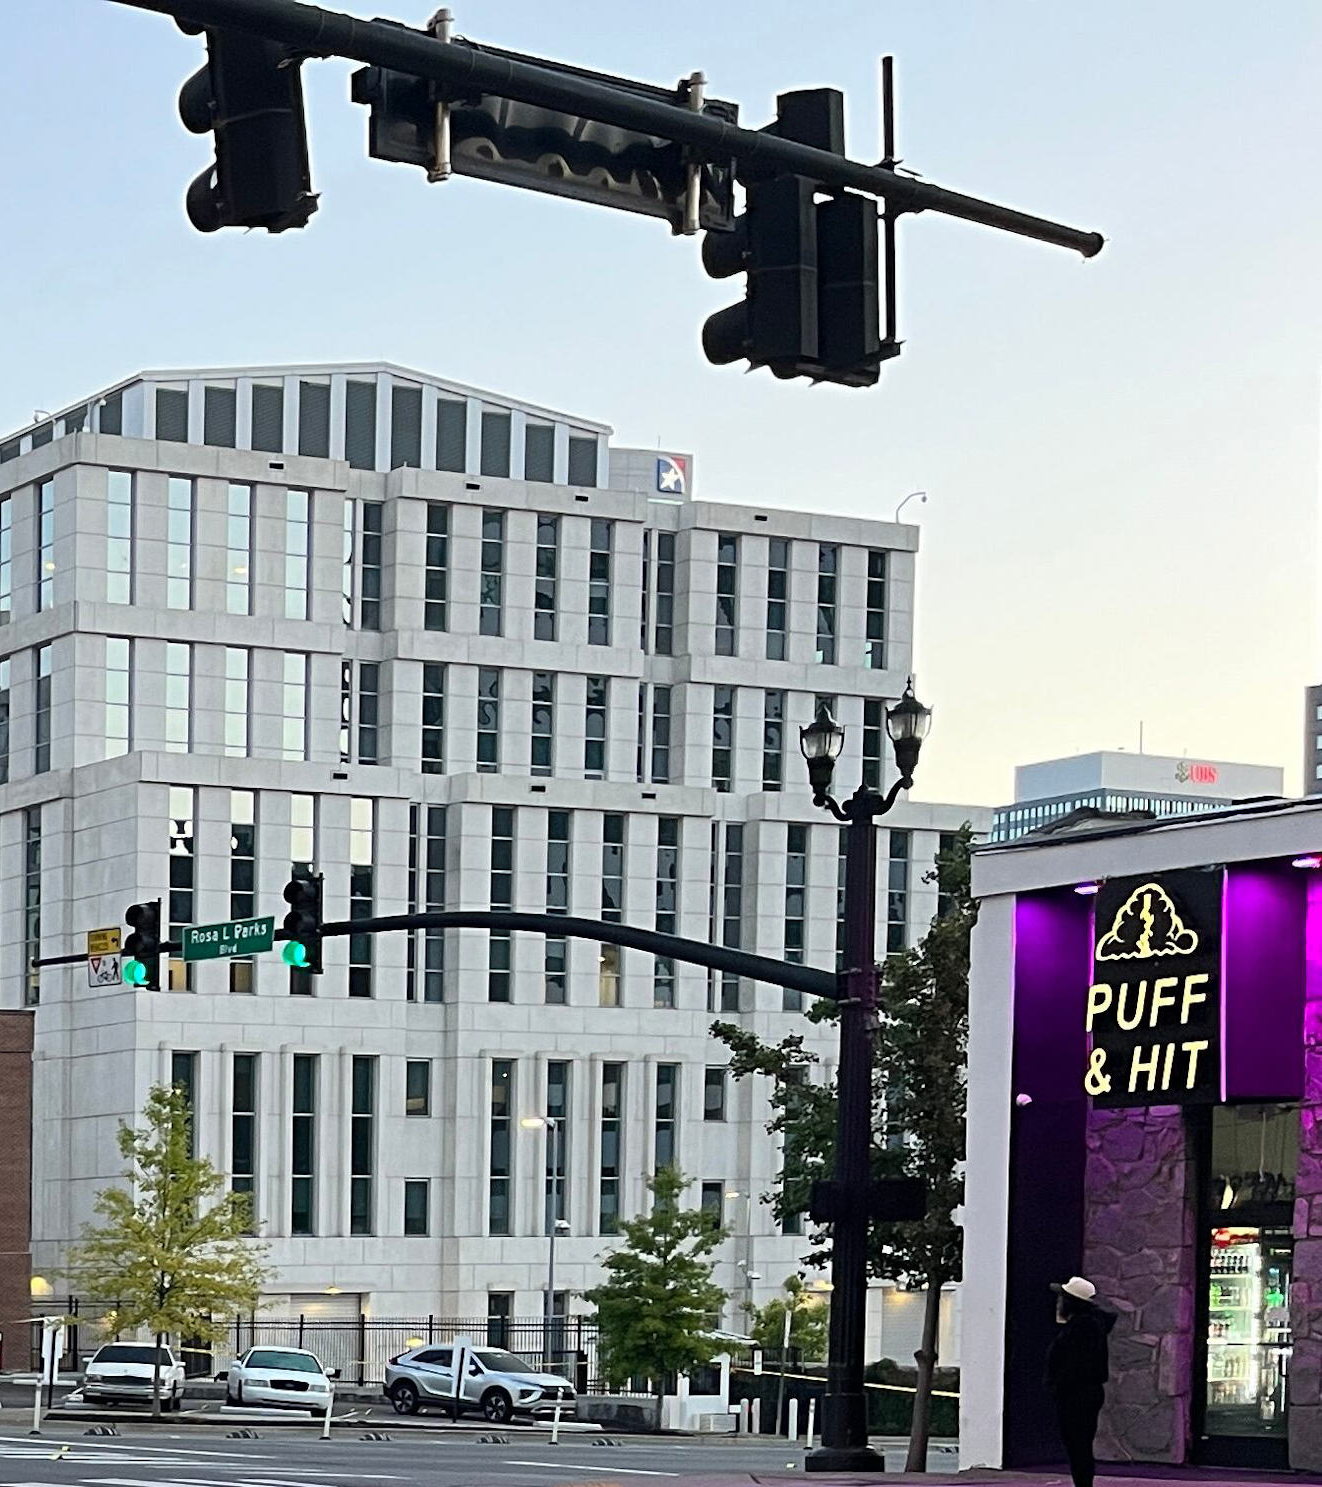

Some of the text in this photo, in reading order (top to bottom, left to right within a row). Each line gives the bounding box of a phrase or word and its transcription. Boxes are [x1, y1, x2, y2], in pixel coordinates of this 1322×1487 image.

[1190, 764, 1218, 784] UBS
[191, 923, 268, 945] Rosa L Parks
[219, 944, 238, 955] Blvd
[1086, 973, 1209, 1032] PUFF
[1084, 1040, 1209, 1096] & HIT
